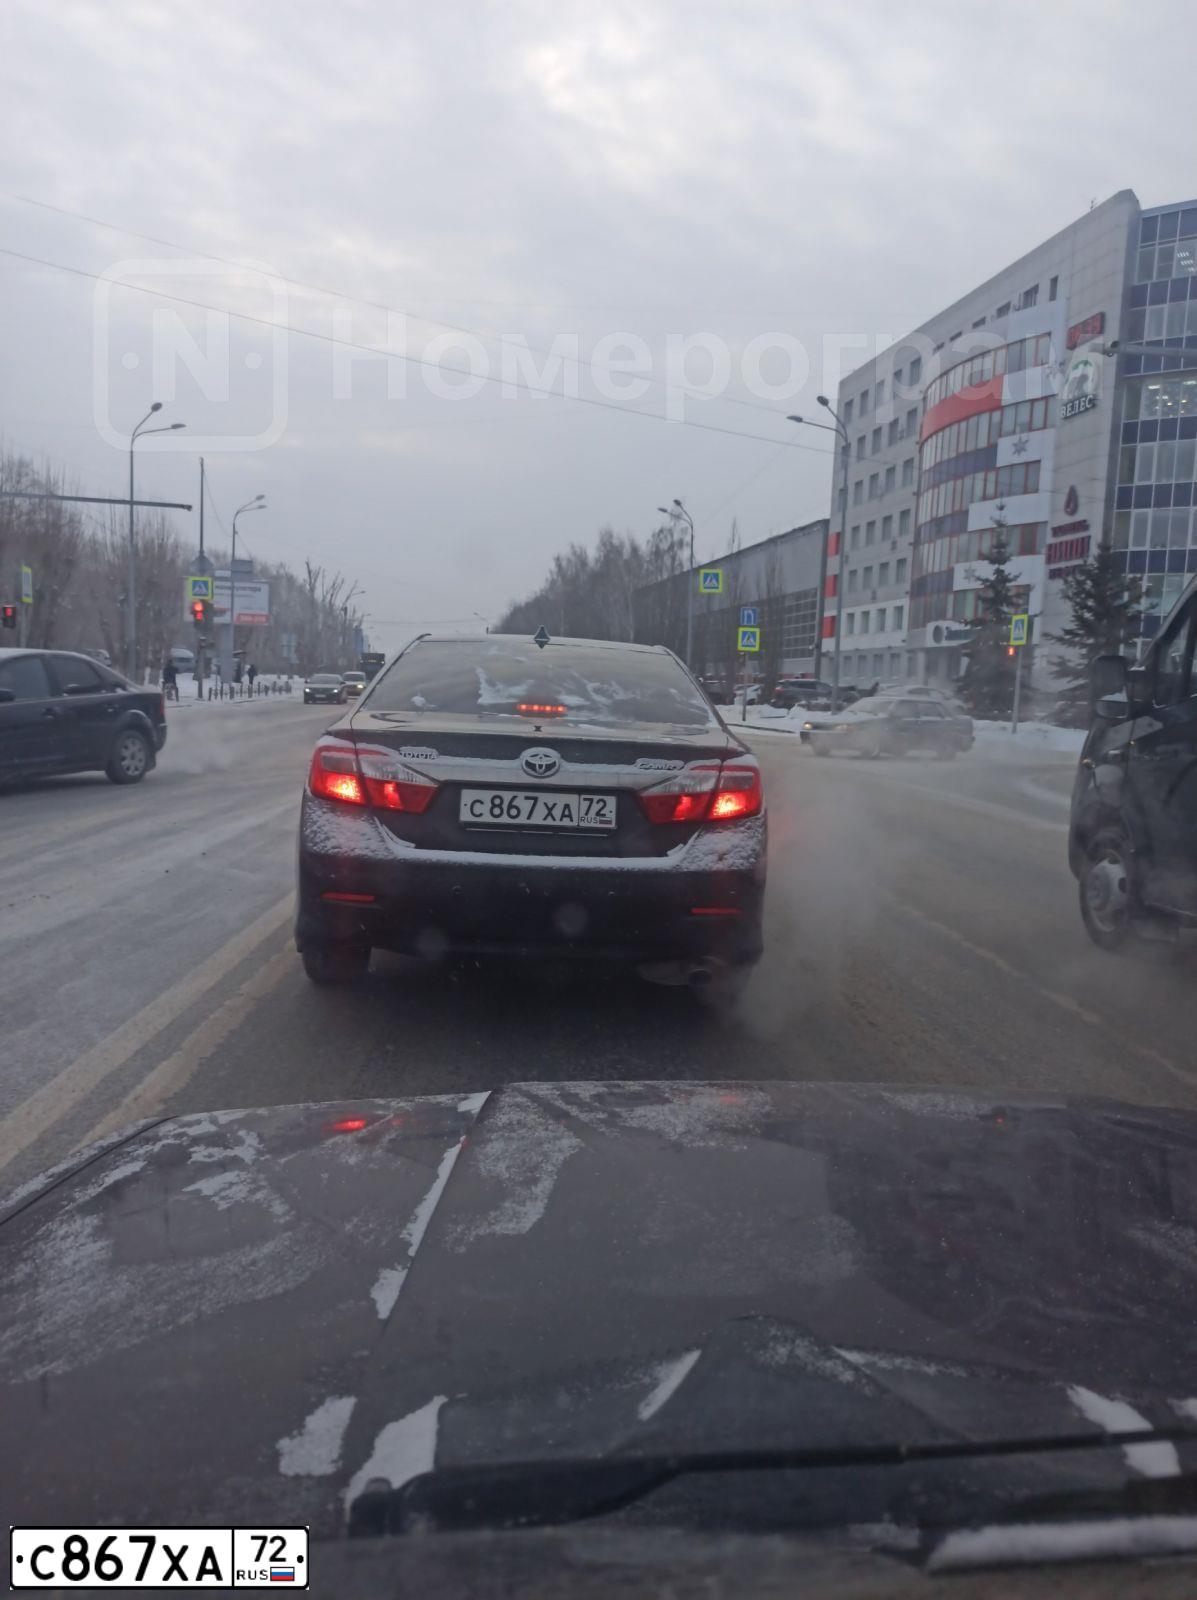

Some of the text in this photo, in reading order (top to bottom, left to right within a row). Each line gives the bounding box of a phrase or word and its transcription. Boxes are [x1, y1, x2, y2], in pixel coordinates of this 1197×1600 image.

[1060, 394, 1095, 418] ВЕЛЕС
[582, 797, 608, 818] 72
[580, 816, 599, 824] RUS
